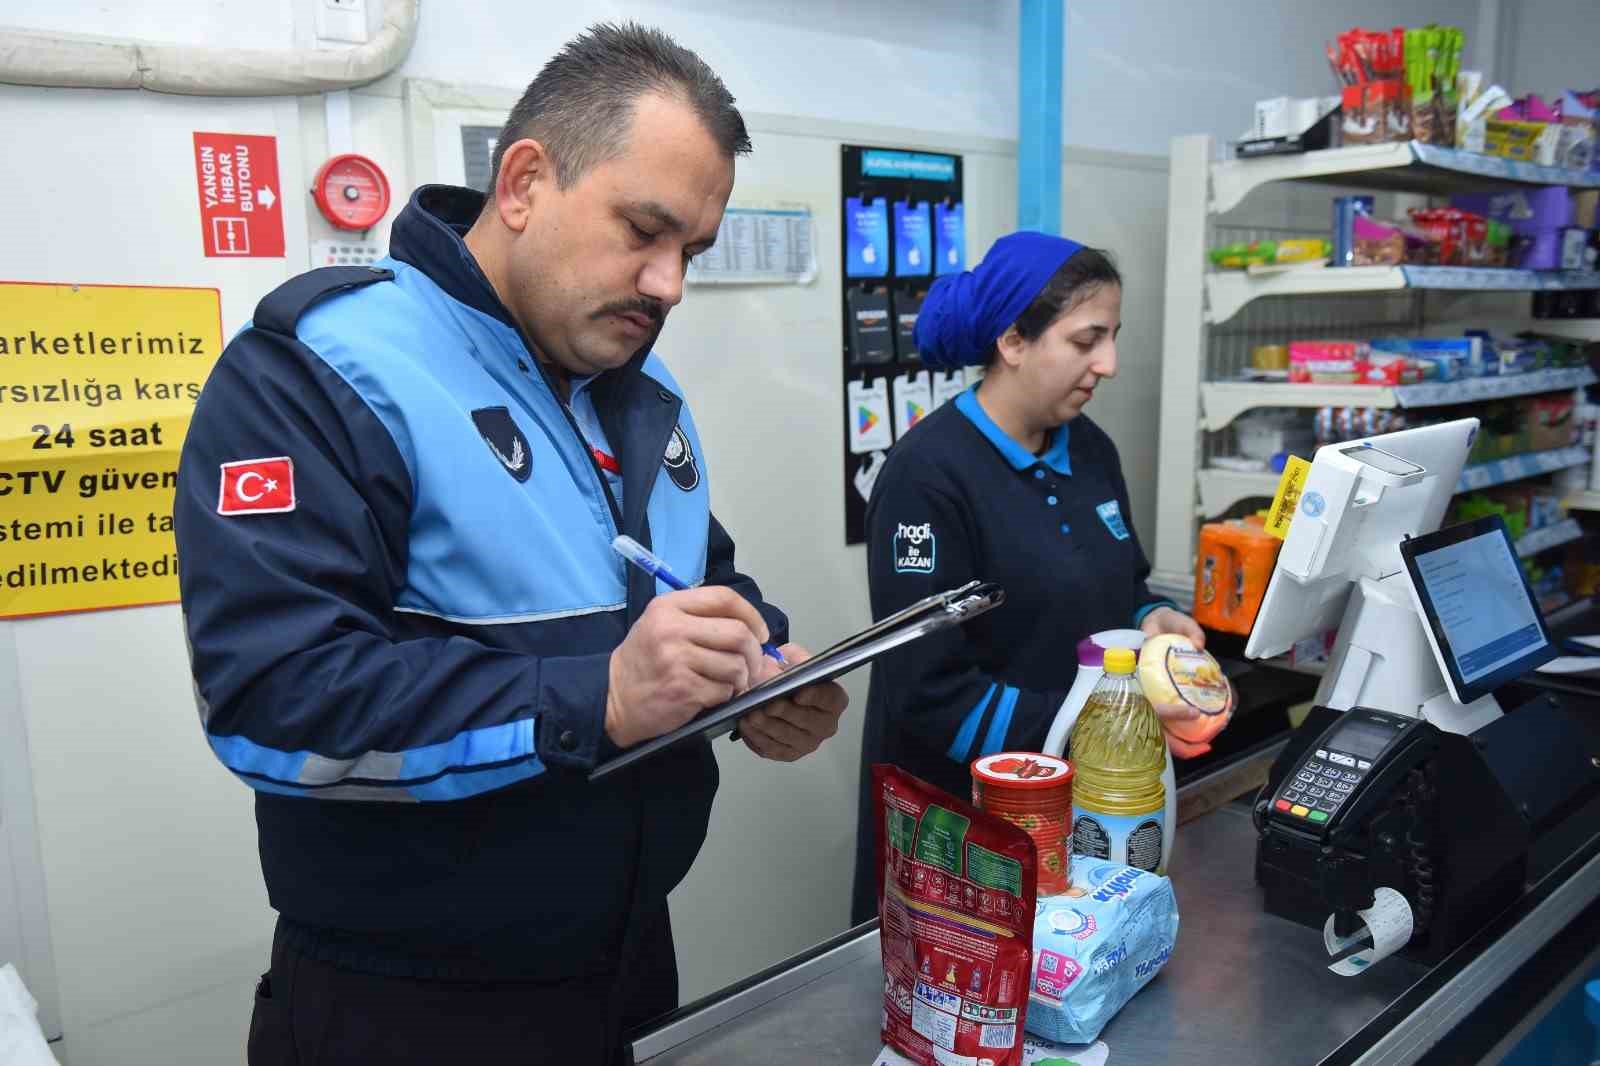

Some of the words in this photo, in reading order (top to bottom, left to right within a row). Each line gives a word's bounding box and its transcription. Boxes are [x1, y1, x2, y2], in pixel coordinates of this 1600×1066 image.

[200, 146, 218, 209] YANGIN
[219, 152, 236, 204] İHBAR
[236, 145, 255, 213] BUTONU
[31, 424, 75, 449] 24
[88, 422, 163, 448] saat
[79, 467, 178, 498] güven
[99, 513, 135, 536] ile
[147, 512, 175, 533] ta
[898, 557, 931, 569] KAZAN
